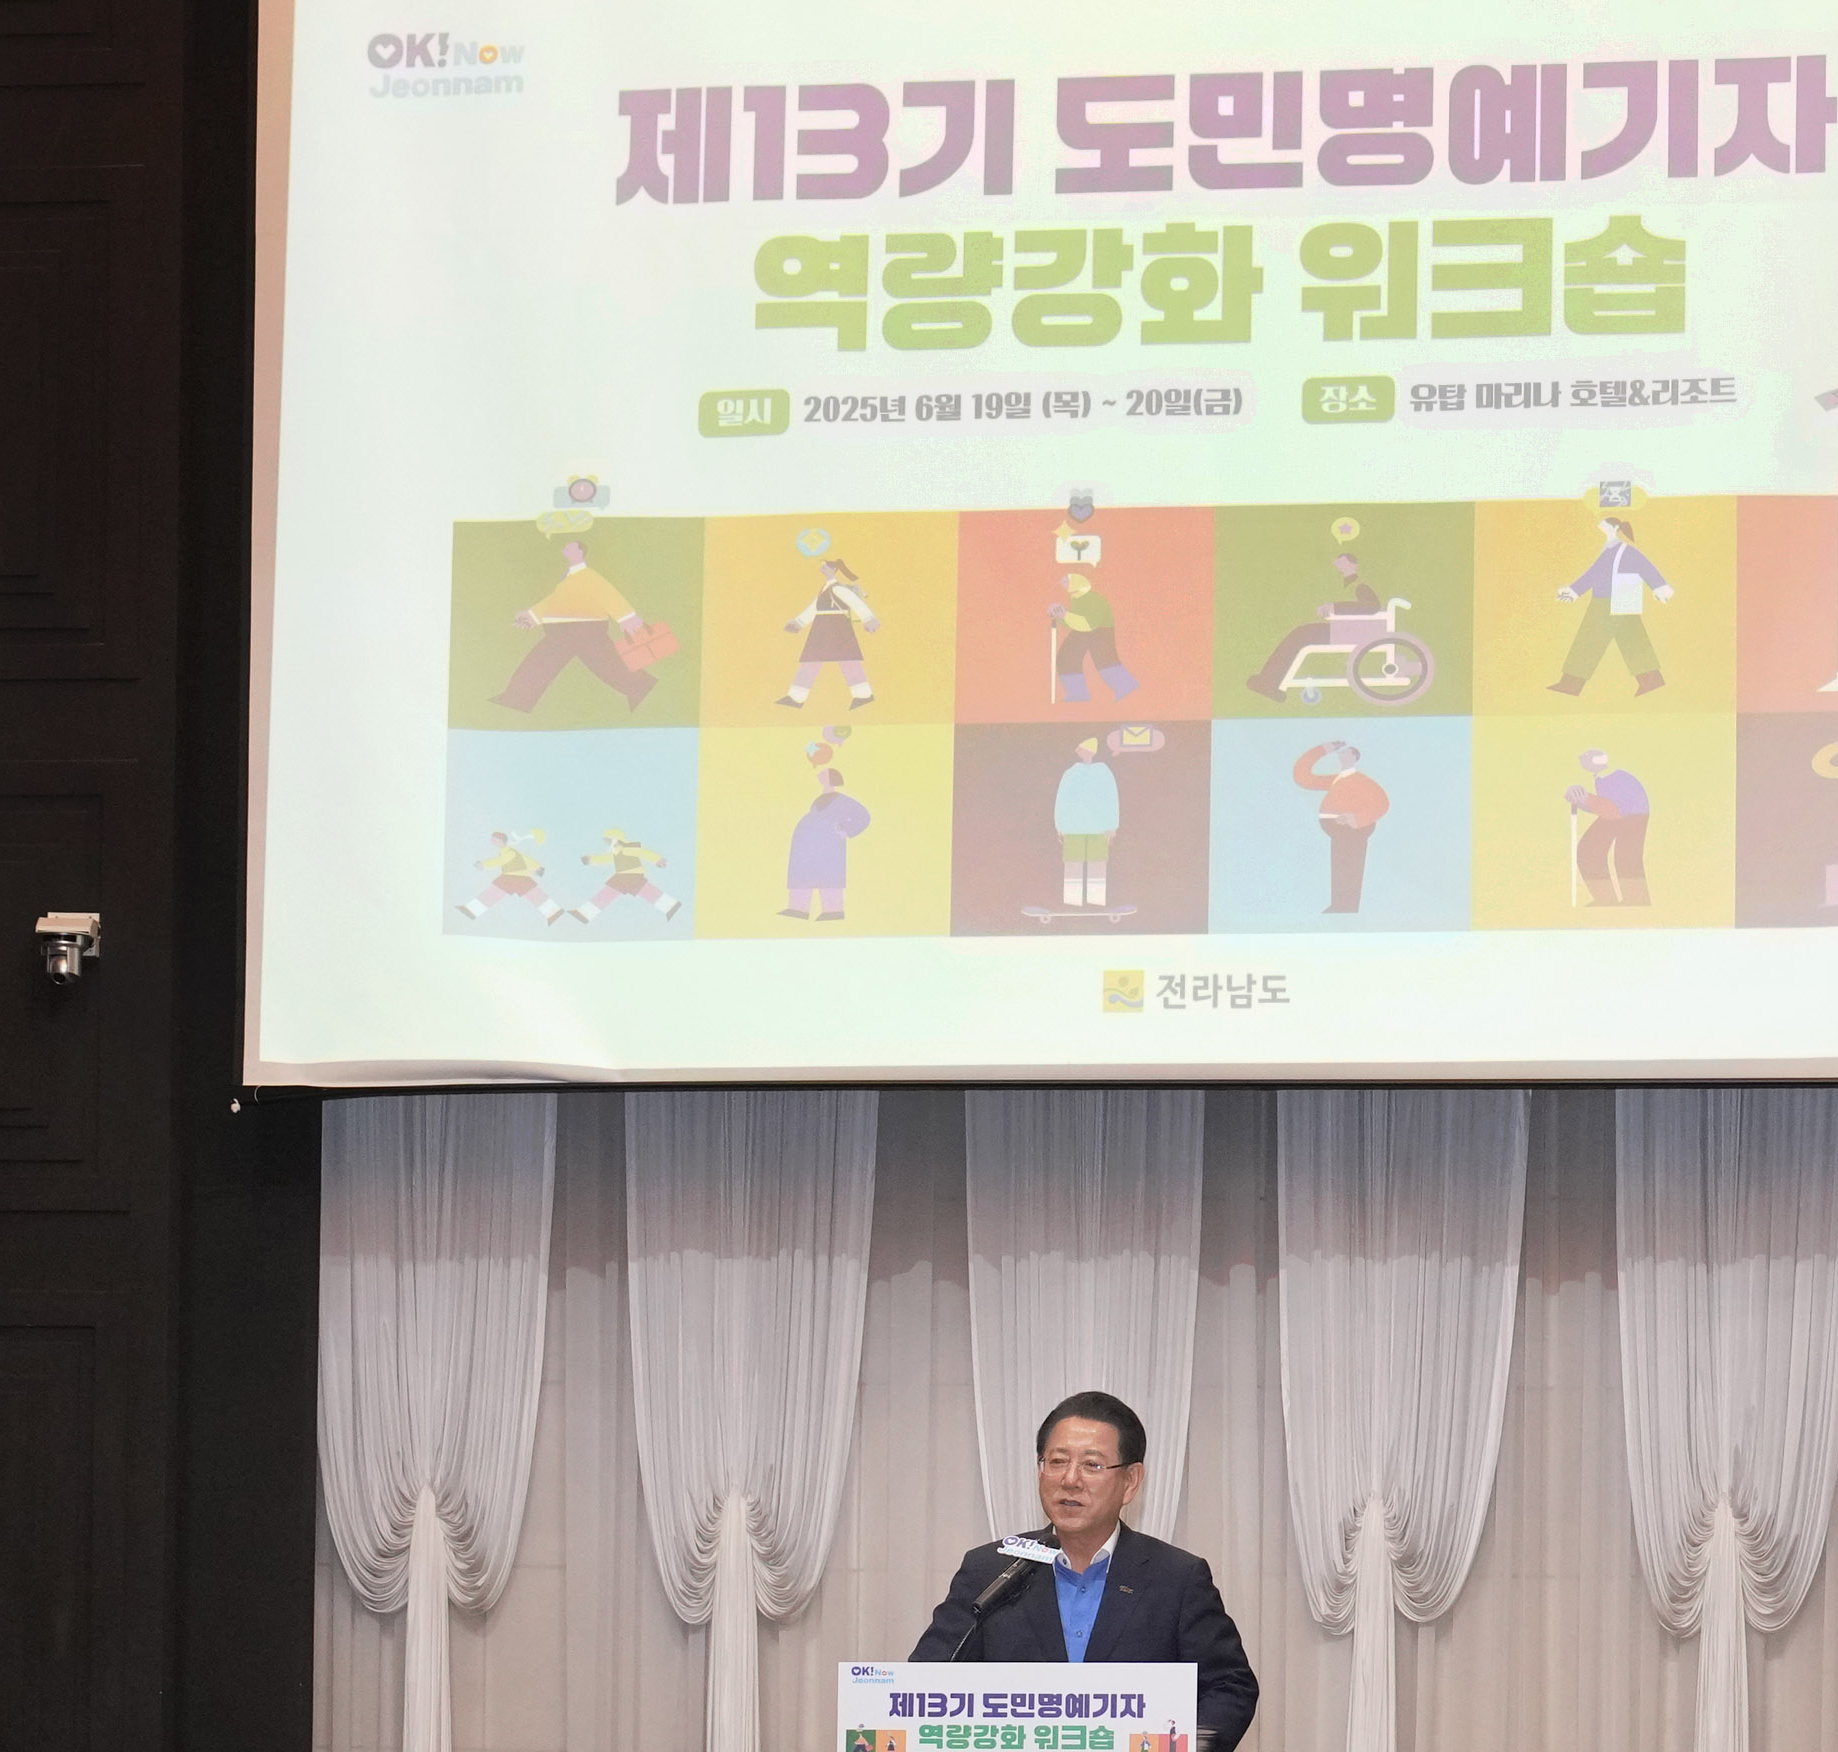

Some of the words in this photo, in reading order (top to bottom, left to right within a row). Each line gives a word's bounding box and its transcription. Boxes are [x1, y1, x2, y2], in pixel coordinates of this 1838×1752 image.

[368, 33, 449, 69] OK!
[454, 43, 524, 65] Now
[370, 74, 523, 98] Jeonnam
[616, 79, 1015, 205] 제13기
[1055, 55, 1837, 194] 도민명예기자
[754, 221, 1263, 352] 역량강화
[1300, 215, 1686, 341] 워크숍
[717, 398, 771, 426] 일시
[804, 396, 906, 422] 2025년
[915, 394, 961, 421] 6월
[972, 392, 1031, 419] 19일
[1042, 391, 1091, 418] (목)
[1126, 388, 1242, 416] 20일(금)
[1320, 385, 1376, 413] 장소
[1410, 384, 1467, 411] 유탑
[1476, 381, 1561, 409] 마리나
[1570, 377, 1740, 408] 호텔&리조트
[1157, 974, 1290, 1009] 전라남도
[852, 1667, 873, 1676] OK!
[889, 1693, 974, 1717] 제13기
[983, 1693, 1145, 1718] 도민명예기자
[919, 1724, 1026, 1749] 역량강화
[1034, 1726, 1114, 1750] 워크숍
